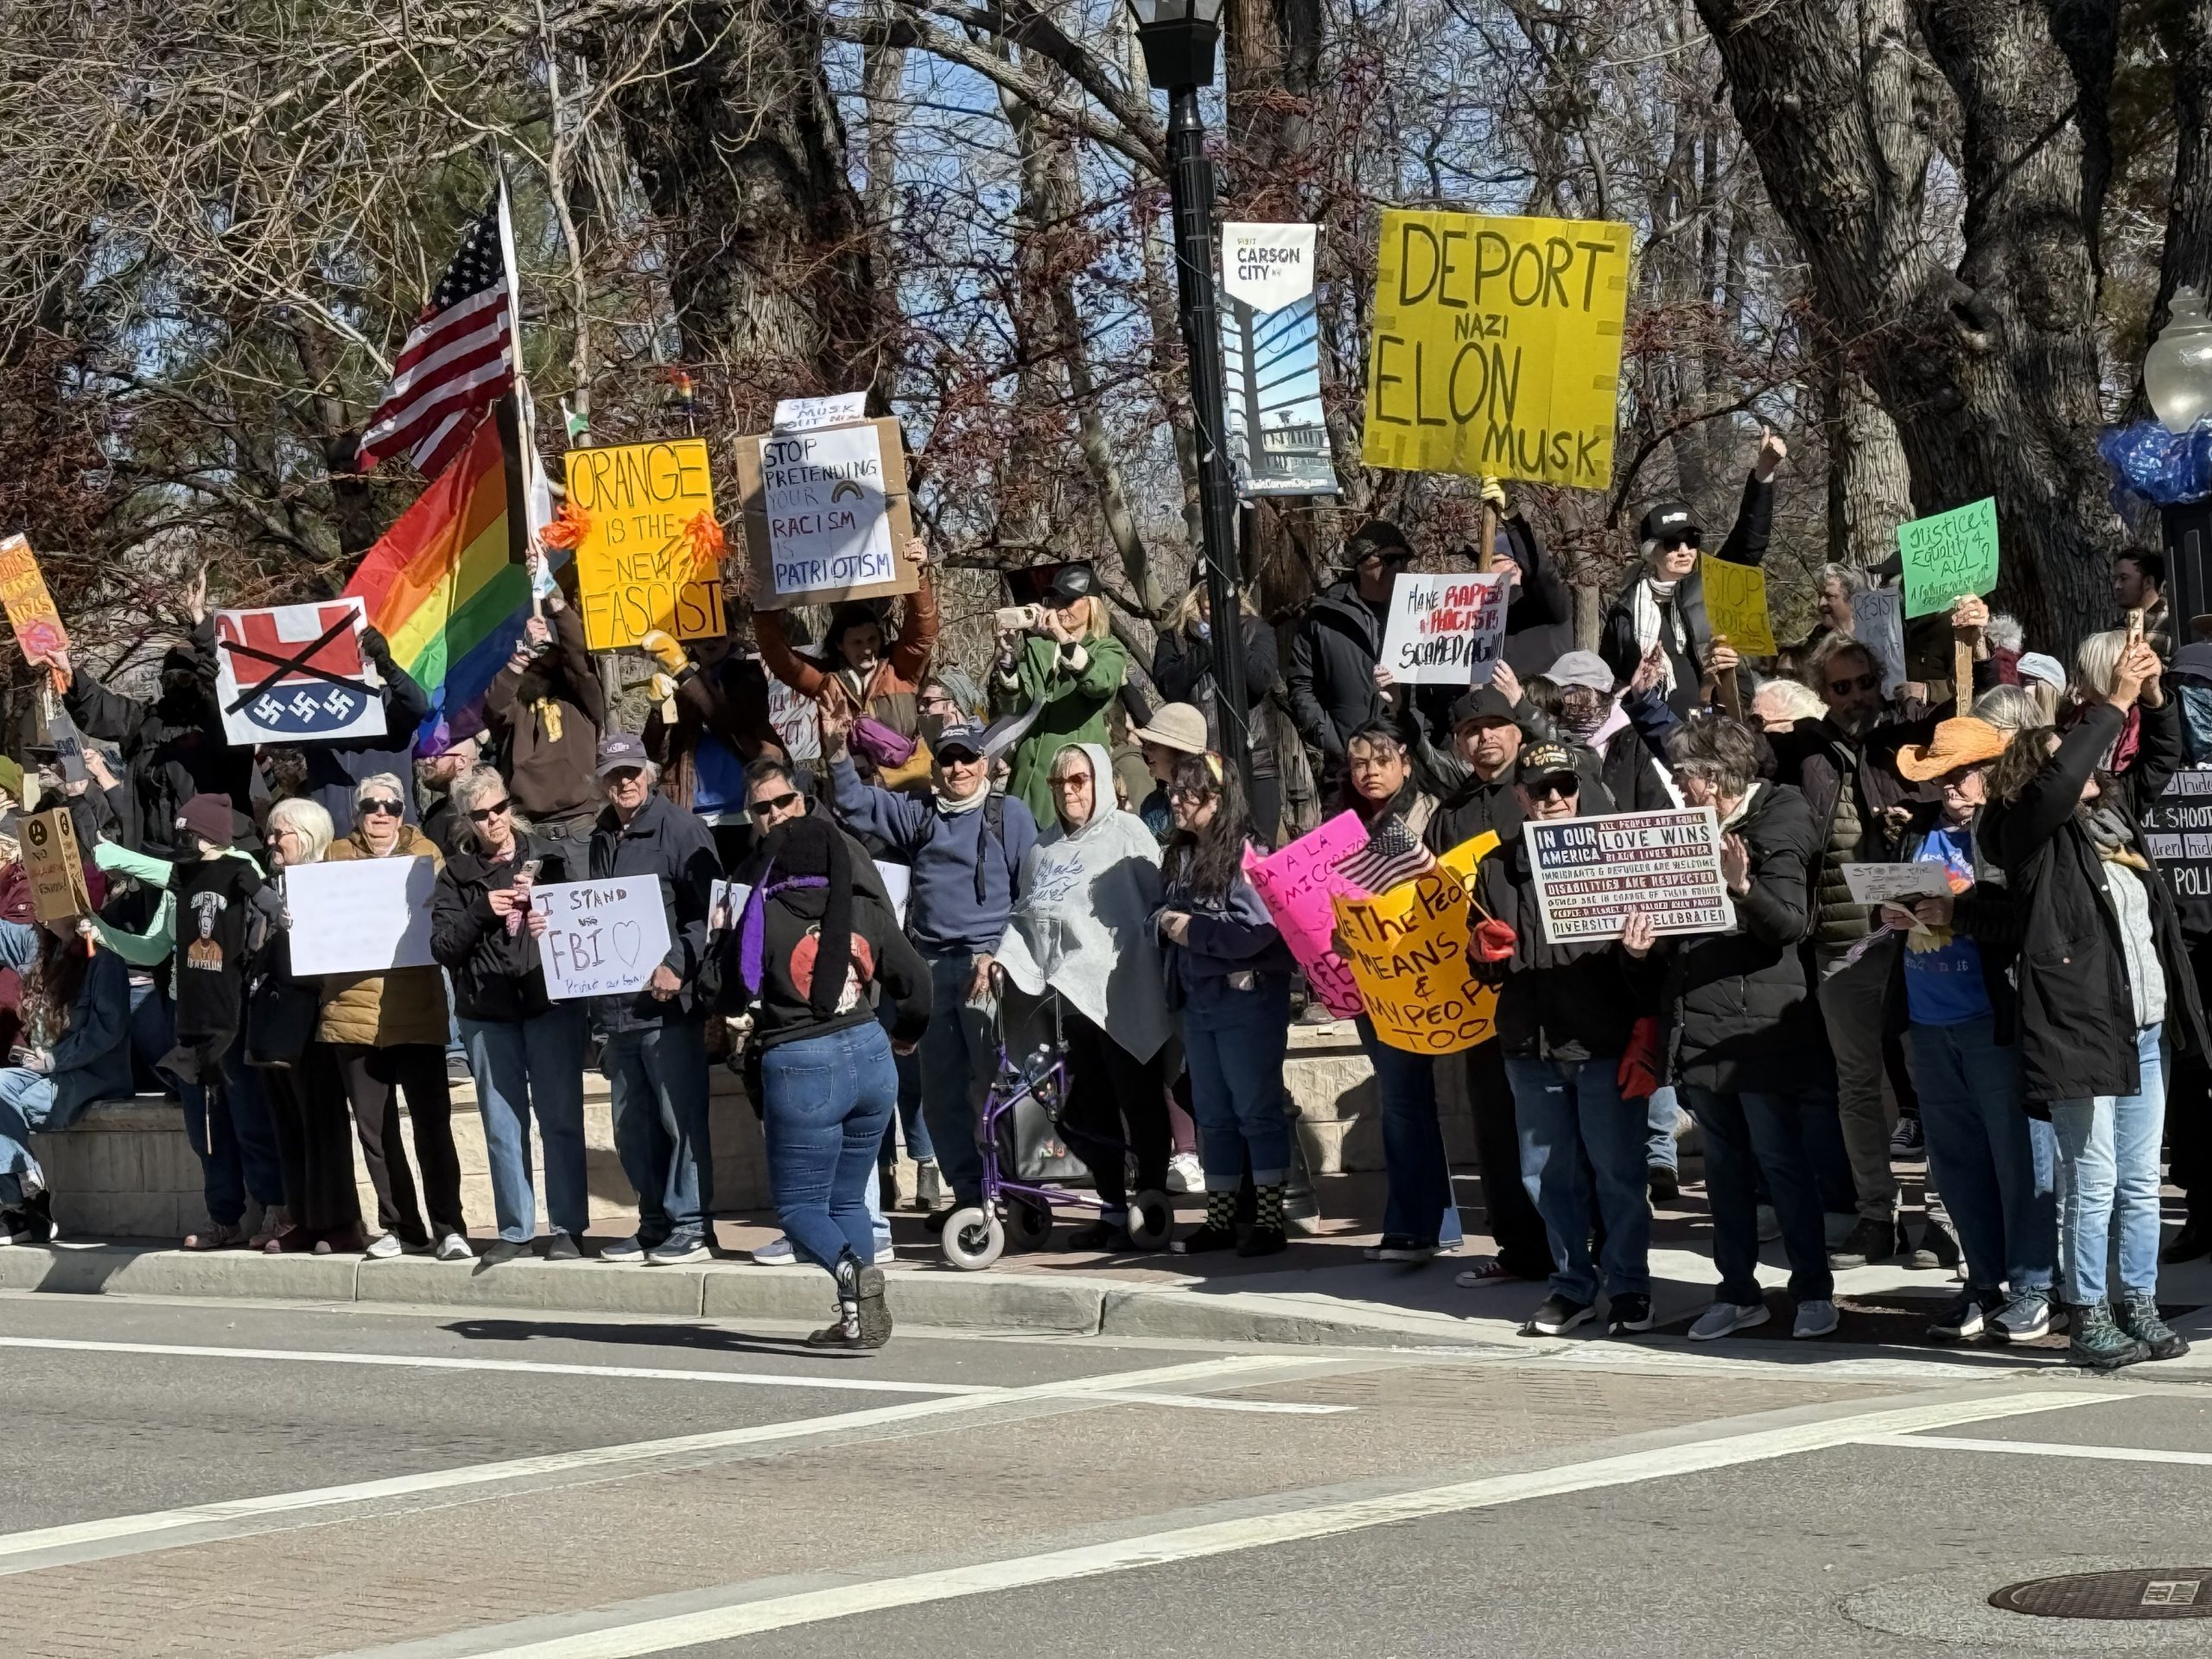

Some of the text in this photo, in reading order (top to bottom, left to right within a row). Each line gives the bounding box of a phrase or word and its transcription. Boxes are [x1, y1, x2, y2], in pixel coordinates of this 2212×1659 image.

[1237, 247, 1300, 264] CARSON
[1399, 222, 1615, 312] DEPORT
[1238, 264, 1269, 280] CITY
[1454, 313, 1509, 342] NAZI
[1376, 334, 1522, 427] ELON
[790, 398, 825, 410] GET
[797, 404, 855, 419] MUSK
[764, 439, 817, 468] STOP
[1481, 420, 1601, 477] MUSK
[572, 444, 707, 512] ORANGE
[766, 460, 878, 489] PRETENDING
[768, 487, 819, 512] YOUR
[606, 514, 679, 546] IS THE
[772, 512, 856, 538] RACISM
[777, 540, 794, 558] IS
[617, 551, 672, 581] NEW
[776, 553, 891, 588] PATRIOTISM
[1706, 565, 1762, 607] STOP
[585, 580, 721, 648] FASCIST
[1854, 594, 1899, 621] RESIST
[1399, 634, 1464, 670] SCARED
[1537, 827, 1597, 849] IN OUR
[1602, 825, 1711, 849] LOVE WINS
[1287, 855, 1300, 871] A
[1304, 834, 1332, 856] LA
[1541, 848, 1601, 865] AMERICA
[1605, 845, 1711, 862] BLACK LIVES MATTER
[1541, 868, 1595, 880] IMMIGRANTS
[1654, 861, 1670, 871] ARE
[1674, 858, 1716, 869] WELCOME
[1548, 880, 1620, 896] DISABILITIES
[1652, 871, 1714, 887] RESPECTED
[536, 888, 627, 916] I STAND
[1552, 918, 1618, 934] DIVERSITY
[549, 928, 606, 980] FBI
[1357, 931, 1459, 980] MEANS
[1363, 991, 1403, 1027] MY
[1392, 1018, 1489, 1049] TOO
